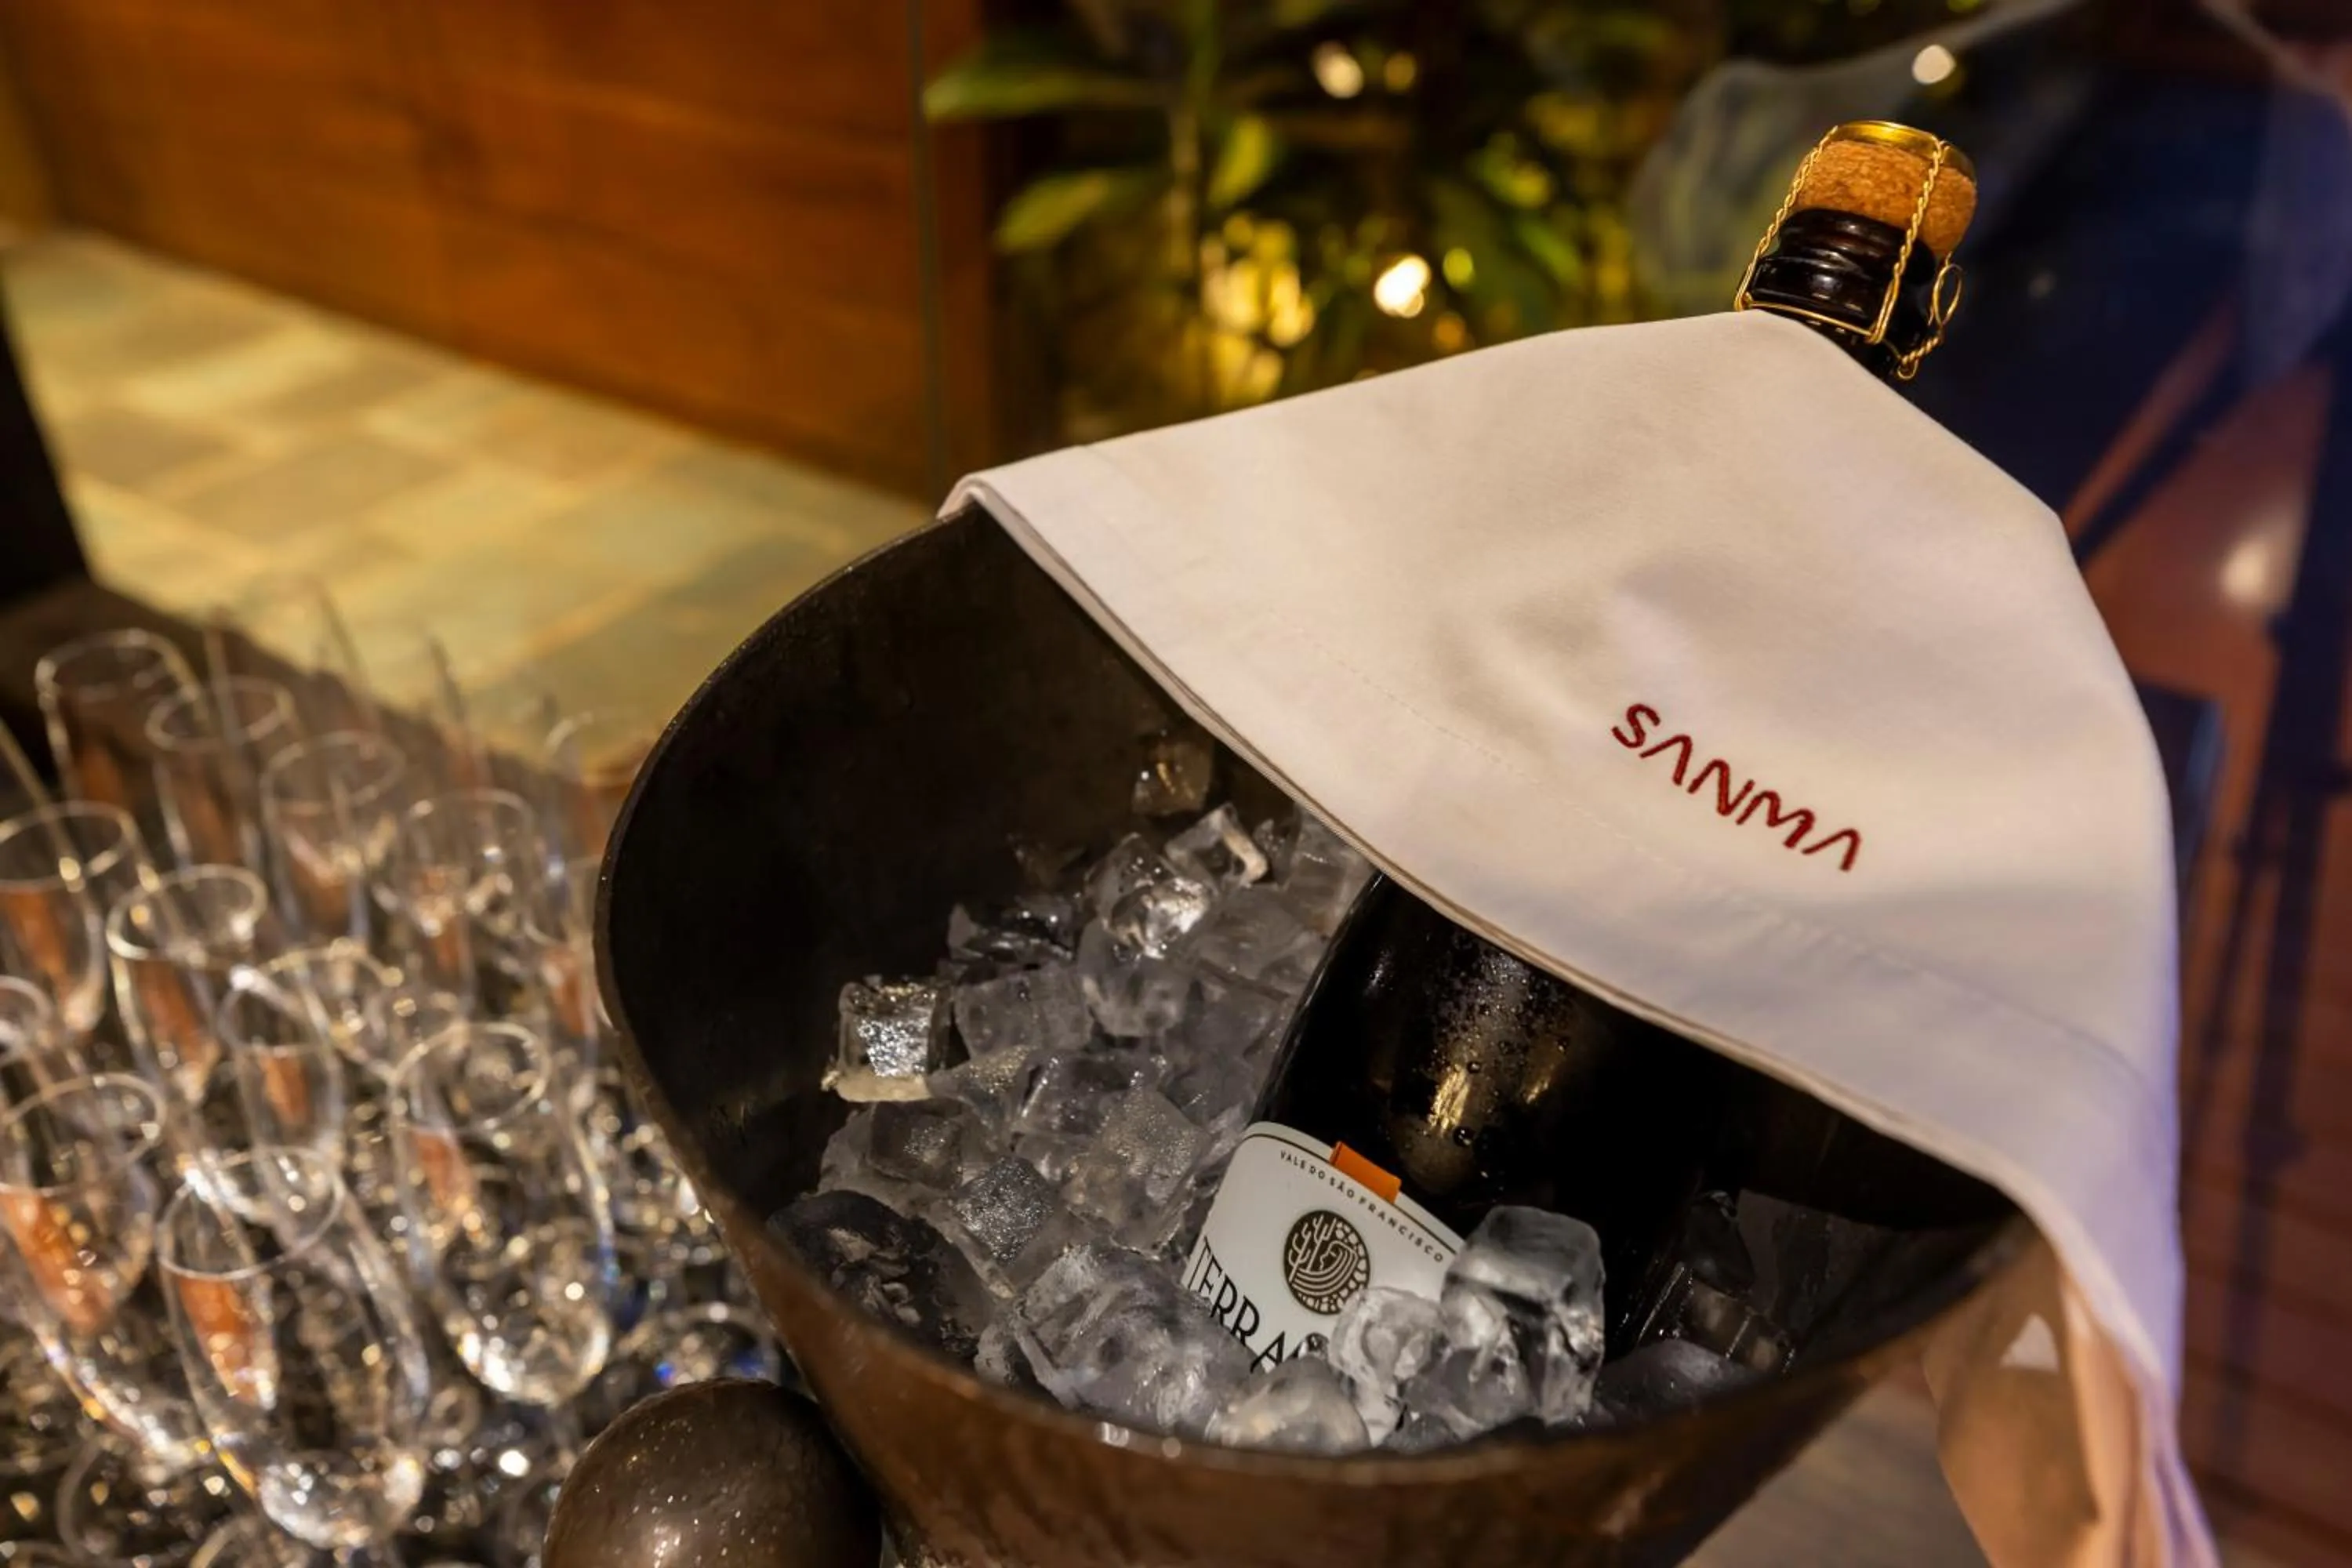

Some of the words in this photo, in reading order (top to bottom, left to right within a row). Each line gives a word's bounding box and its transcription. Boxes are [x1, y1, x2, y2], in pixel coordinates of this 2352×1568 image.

[1611, 703, 1861, 872] SANMA
[1279, 1150, 1305, 1169] VALE
[1309, 1165, 1326, 1180] DO
[1330, 1178, 1355, 1199] SÃO
[1359, 1196, 1444, 1264] FRANCISCO
[1187, 1235, 1303, 1374] TERRA
